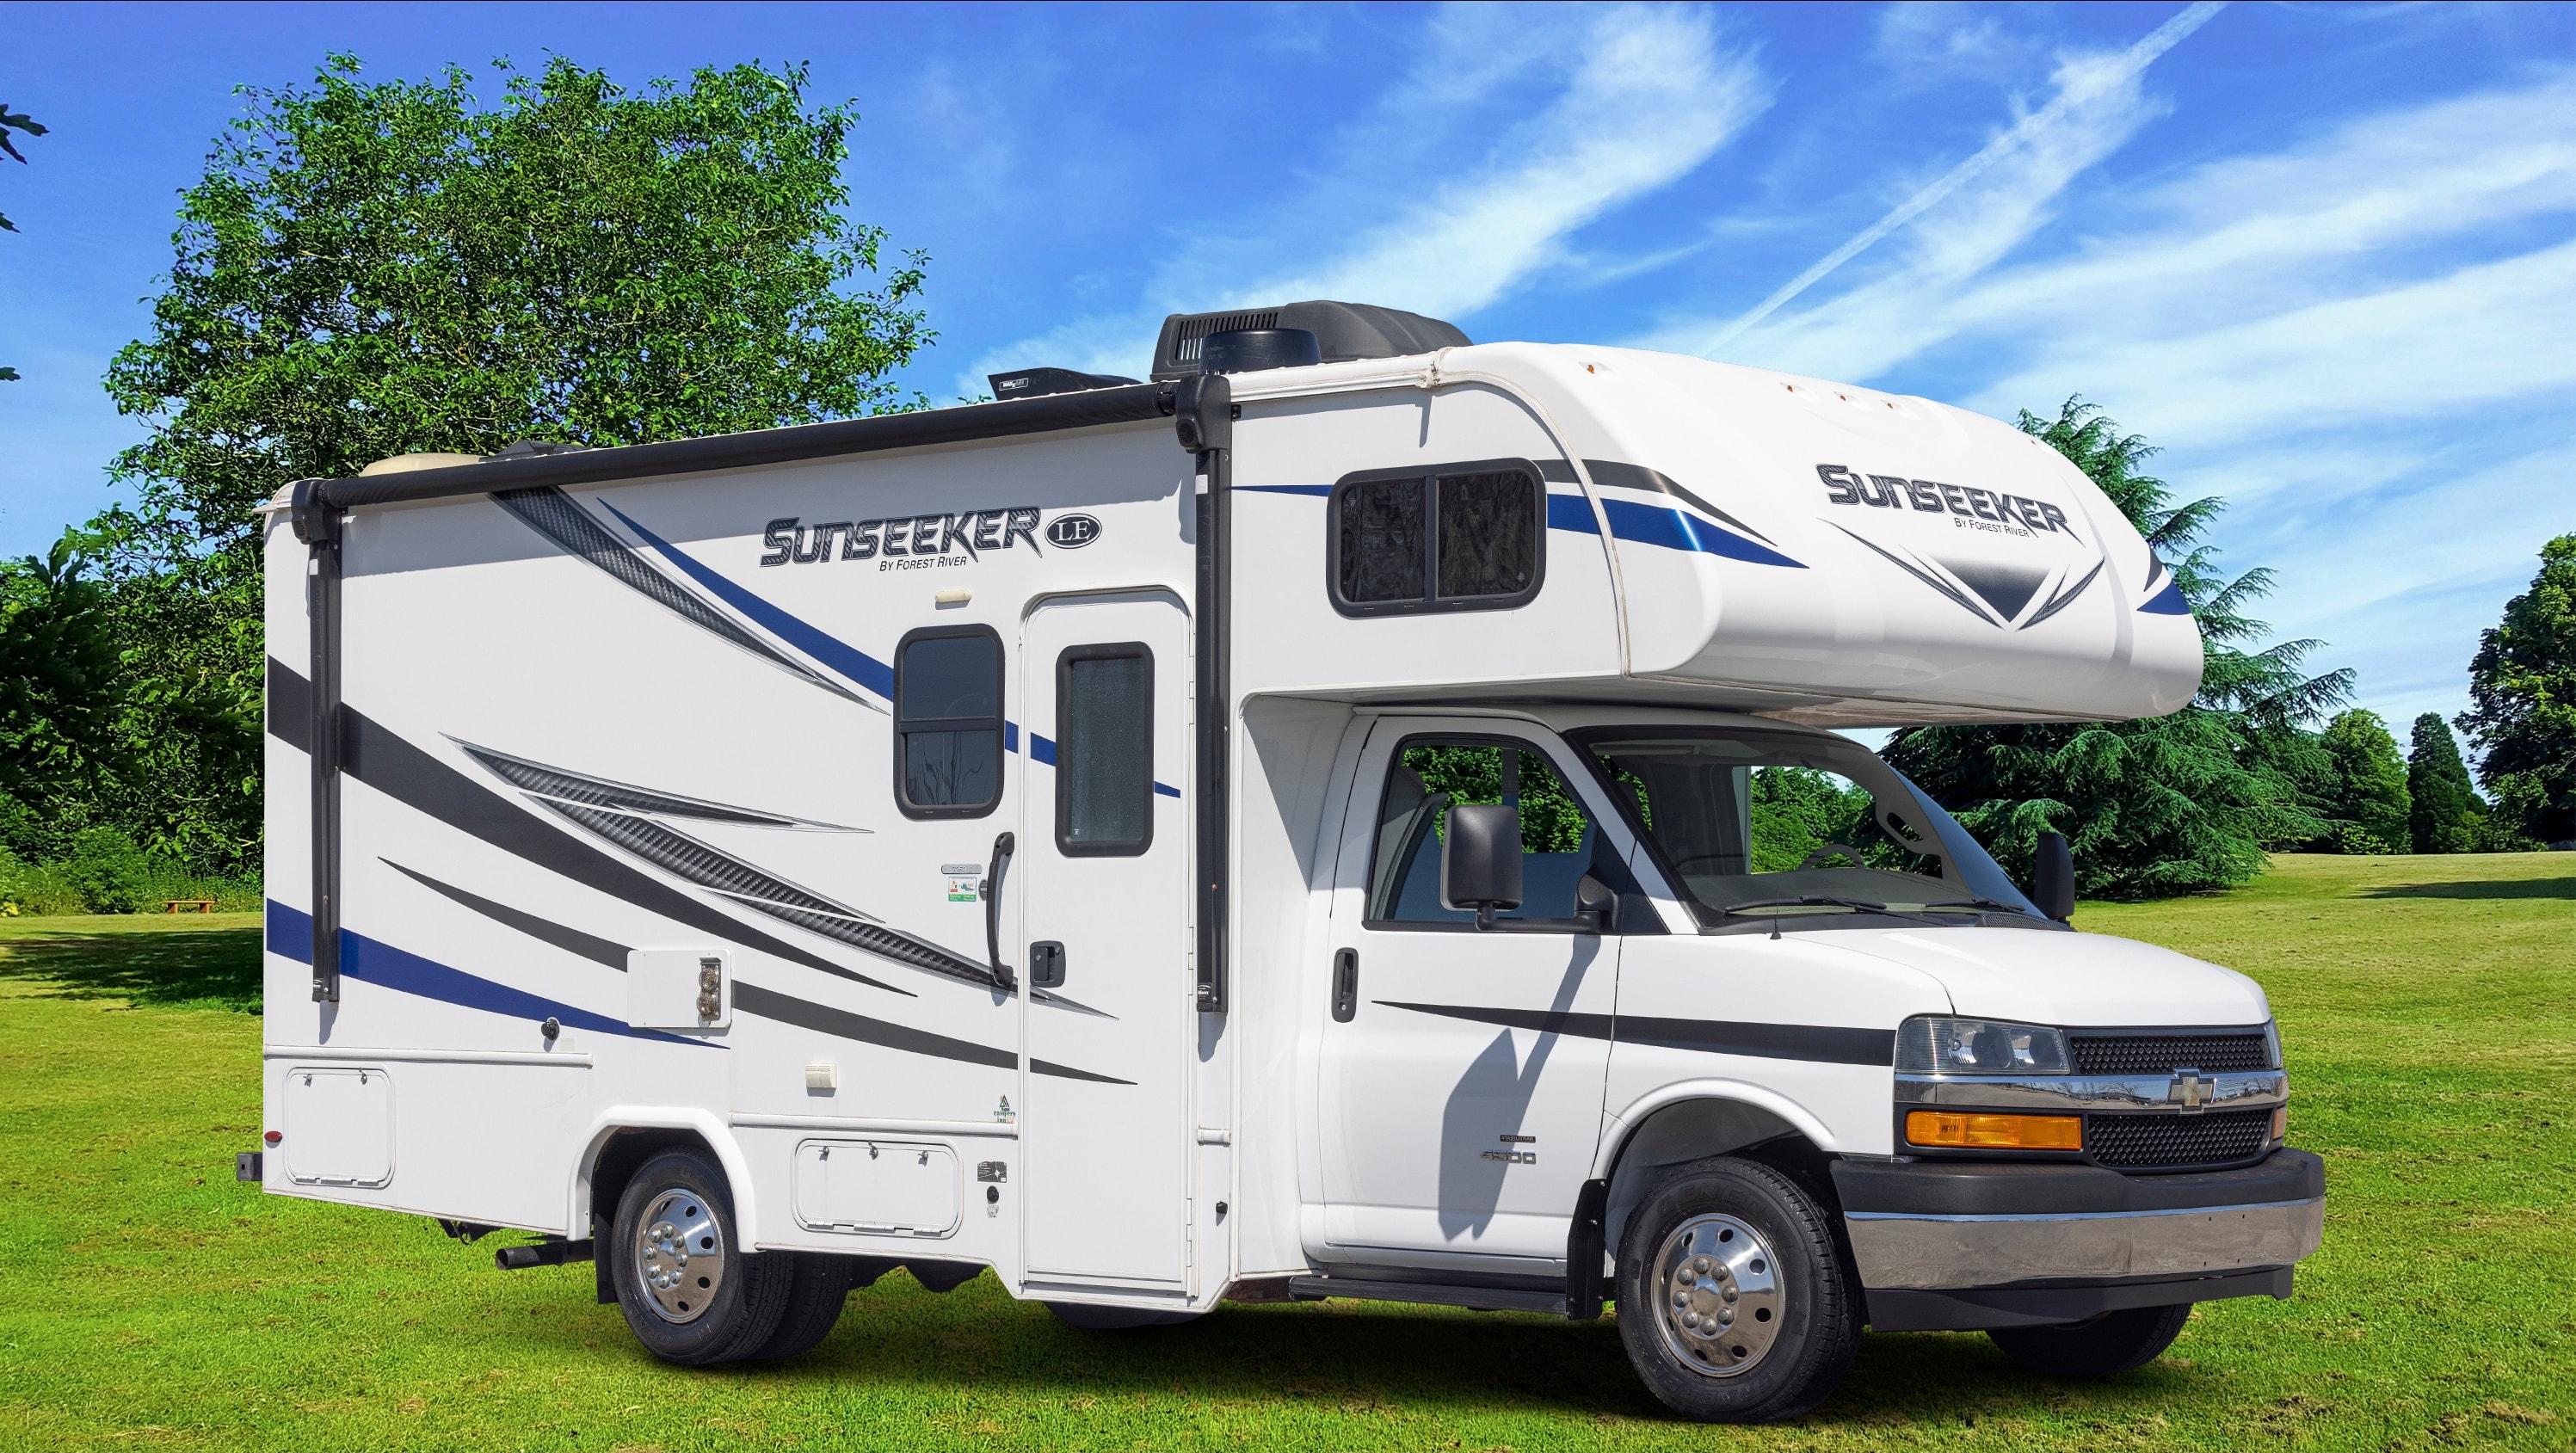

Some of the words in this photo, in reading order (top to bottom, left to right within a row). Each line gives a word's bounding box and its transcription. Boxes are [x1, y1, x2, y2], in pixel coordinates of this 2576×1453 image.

[1057, 519, 1093, 542] LE
[1969, 520, 2002, 533] FOREST
[2004, 525, 2030, 538] RIVER
[896, 558, 935, 570] FOREST
[937, 556, 967, 568] RIVER
[1480, 1149, 1536, 1165] 4500
